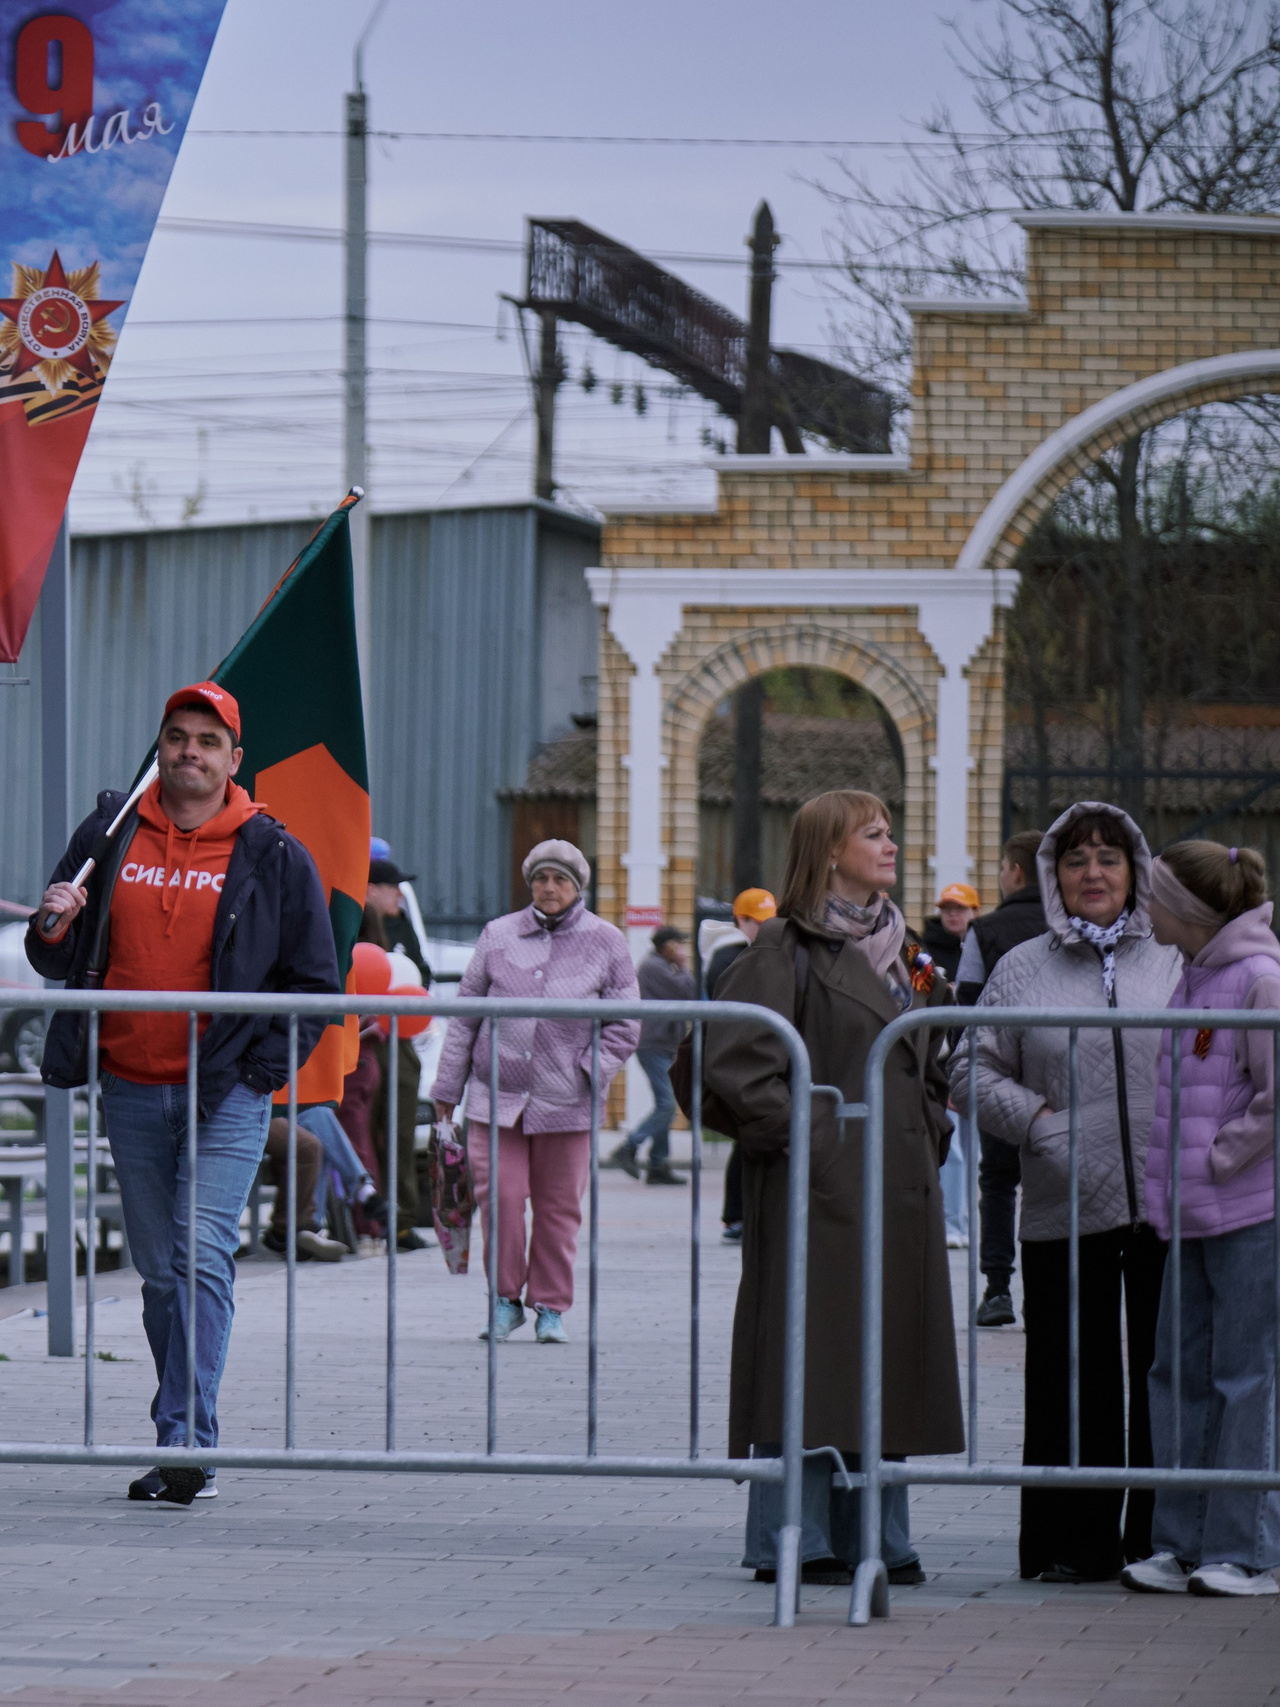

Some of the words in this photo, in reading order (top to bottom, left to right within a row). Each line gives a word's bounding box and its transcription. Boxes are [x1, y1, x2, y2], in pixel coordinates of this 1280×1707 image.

[15, 14, 94, 159] 9
[46, 101, 176, 164] мая
[21, 290, 84, 352] ОТЕЧЕСТВЕННАЯ
